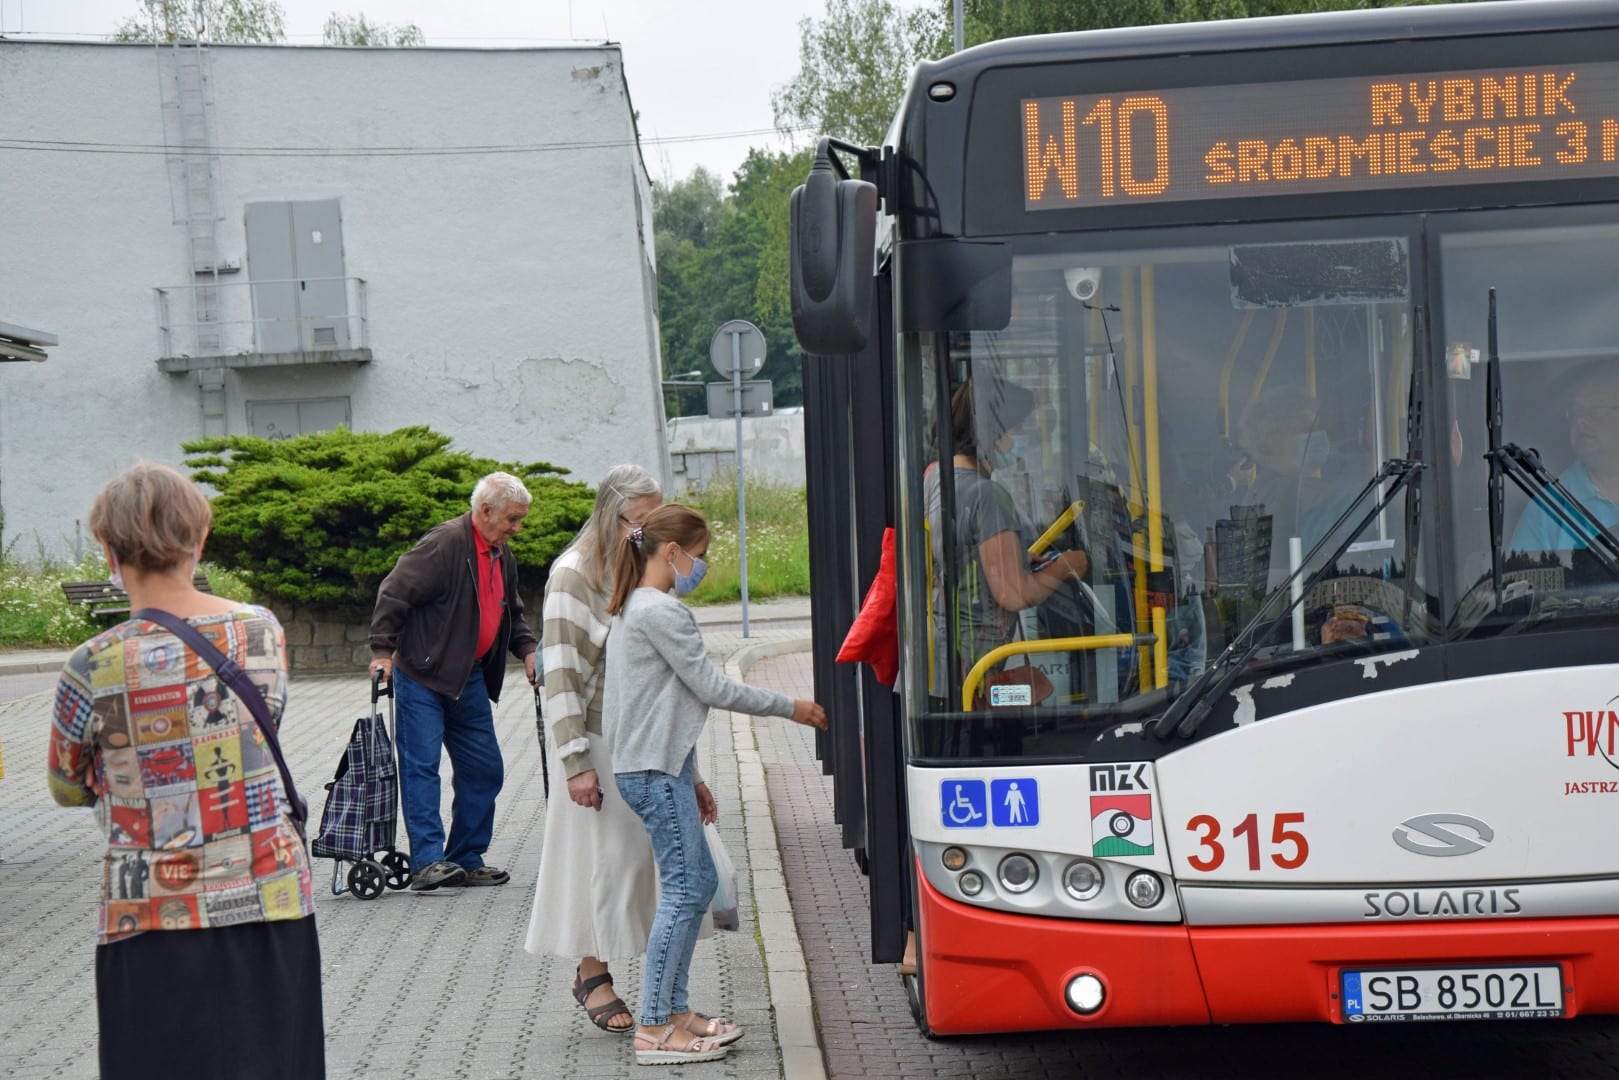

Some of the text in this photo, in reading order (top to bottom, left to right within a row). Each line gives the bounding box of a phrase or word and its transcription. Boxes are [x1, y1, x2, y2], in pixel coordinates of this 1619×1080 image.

[1371, 71, 1576, 127] RYBNIK
[1025, 96, 1169, 200] W10
[1555, 121, 1588, 164] 3
[1089, 764, 1149, 791] MZK
[1565, 781, 1619, 795] JASTRZ
[1186, 812, 1309, 872] 315
[1364, 889, 1521, 917] SOLARIS
[1347, 1000, 1361, 1009] PL
[1368, 973, 1556, 1011] SB 8502L
[1366, 1014, 1405, 1022] SOLARIS
